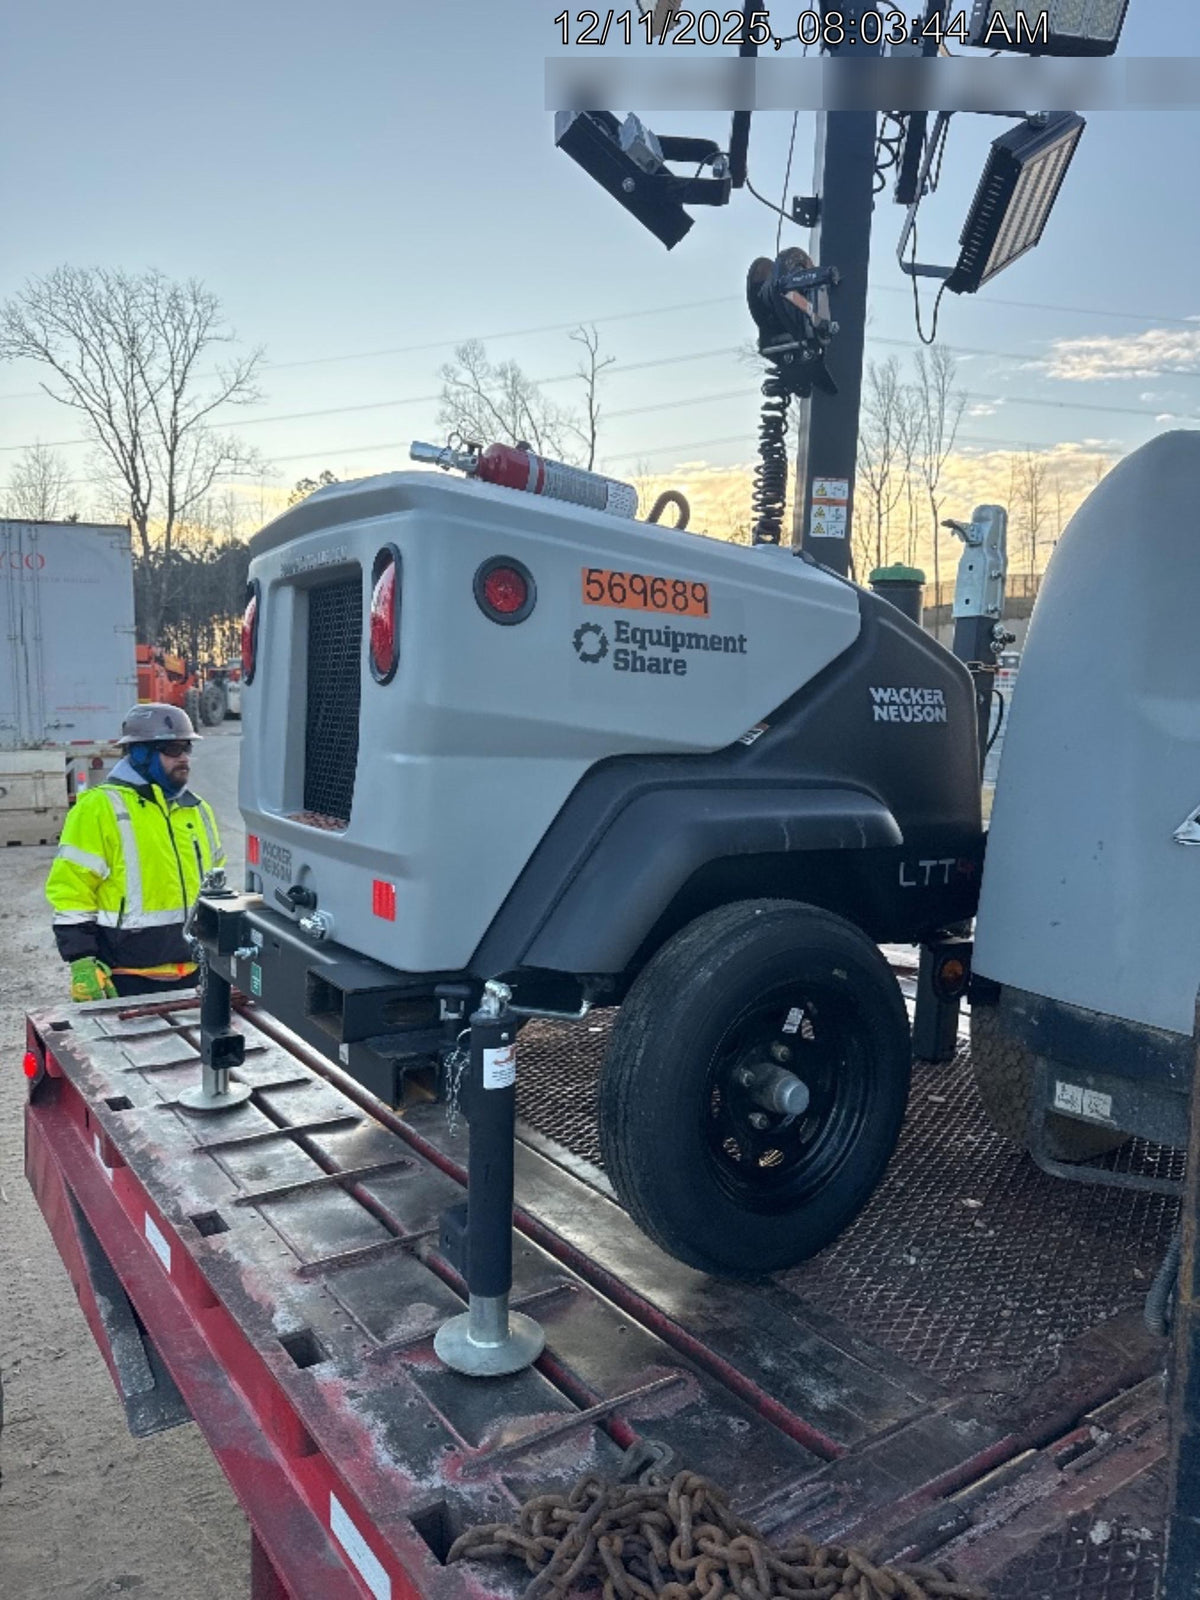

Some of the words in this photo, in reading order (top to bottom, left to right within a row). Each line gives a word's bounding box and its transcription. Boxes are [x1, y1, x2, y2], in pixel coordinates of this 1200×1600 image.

[585, 568, 709, 614] 569689
[614, 620, 748, 654] Equipment
[613, 648, 687, 676] Share
[869, 687, 946, 706] WACKER
[872, 705, 948, 723] NEUSON
